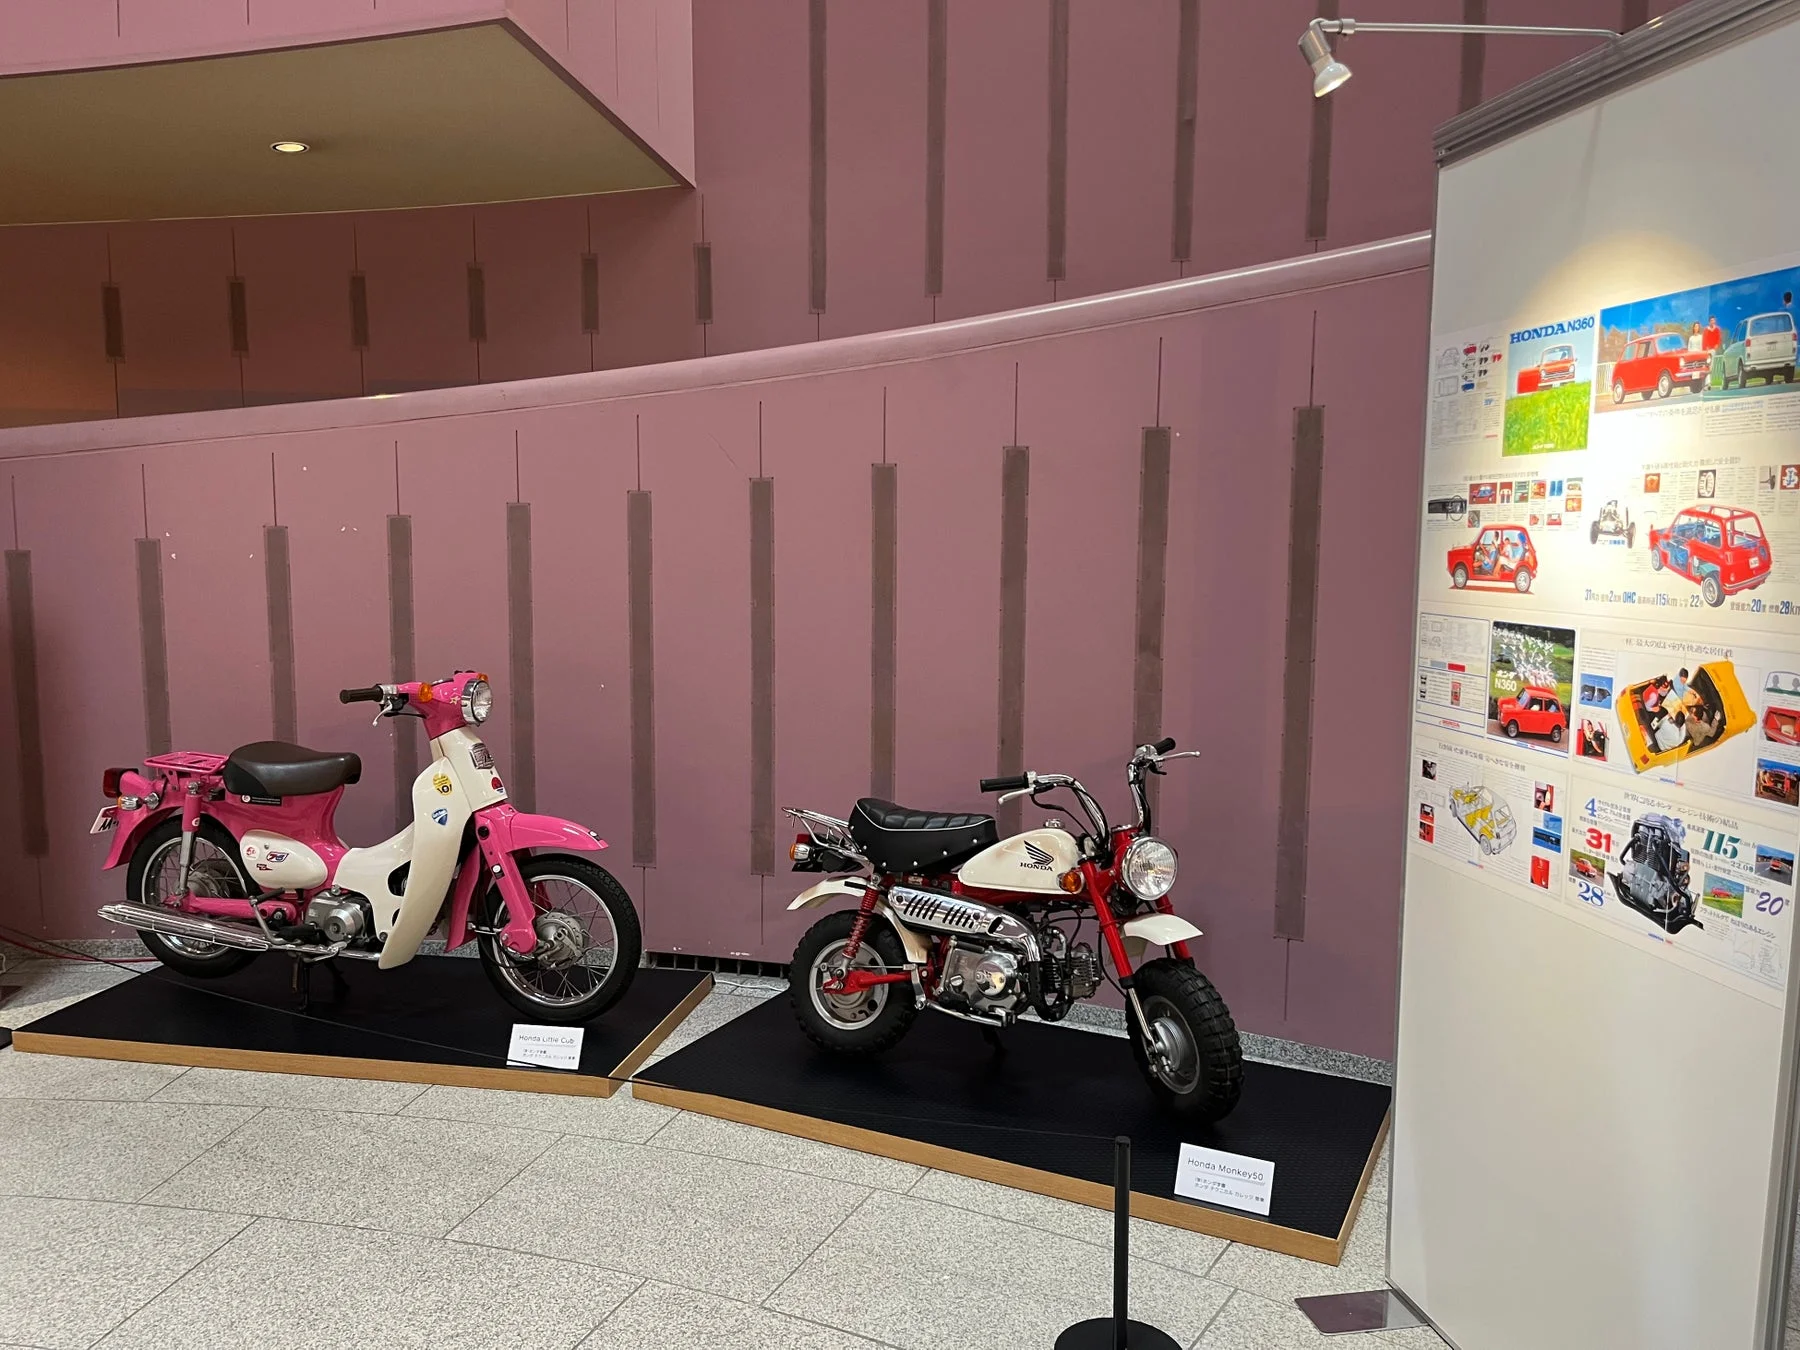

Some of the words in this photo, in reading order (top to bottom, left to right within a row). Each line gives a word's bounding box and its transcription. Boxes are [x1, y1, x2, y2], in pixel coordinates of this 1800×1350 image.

[1509, 322, 1566, 345] HONDA
[1566, 316, 1596, 334] N360
[1494, 677, 1517, 692] N360
[1584, 797, 1597, 818] 4
[1585, 827, 1612, 854] 31
[1702, 829, 1741, 860] 115
[1020, 862, 1053, 871] HONDA
[1577, 880, 1604, 907] 28
[1756, 891, 1785, 916] 20
[1187, 1157, 1216, 1171] Honda
[1218, 1164, 1264, 1181] Monkey50
